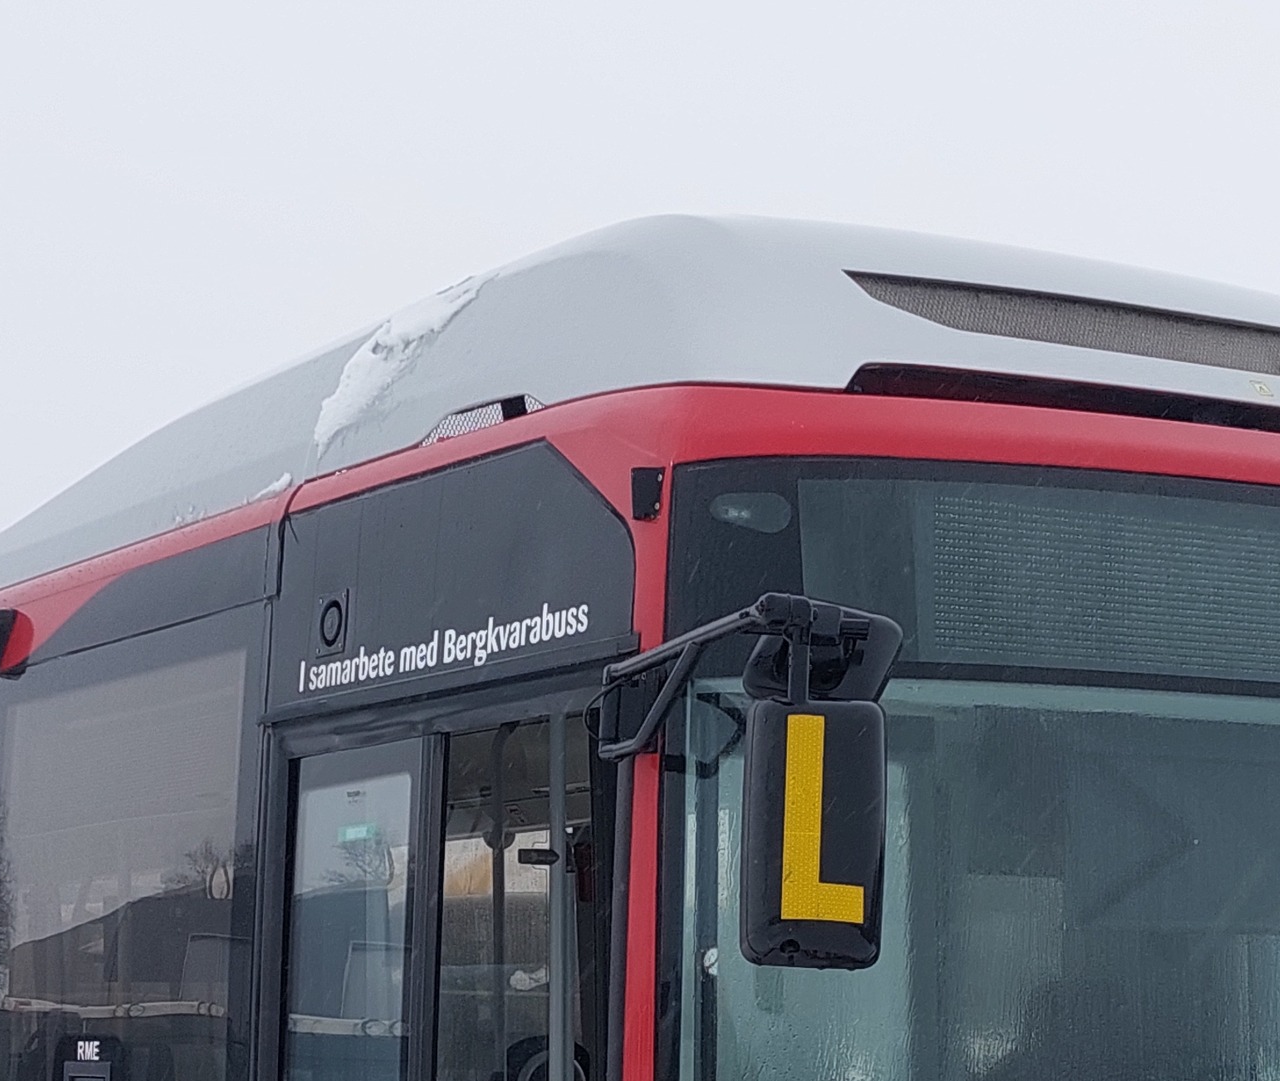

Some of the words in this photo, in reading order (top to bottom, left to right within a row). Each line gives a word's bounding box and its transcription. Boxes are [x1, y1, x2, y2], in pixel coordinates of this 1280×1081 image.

[298, 660, 306, 693] I
[308, 646, 395, 692] samarbete
[399, 630, 440, 674] med
[442, 602, 590, 667] Bergkvarabuss
[77, 1040, 101, 1061] RME
